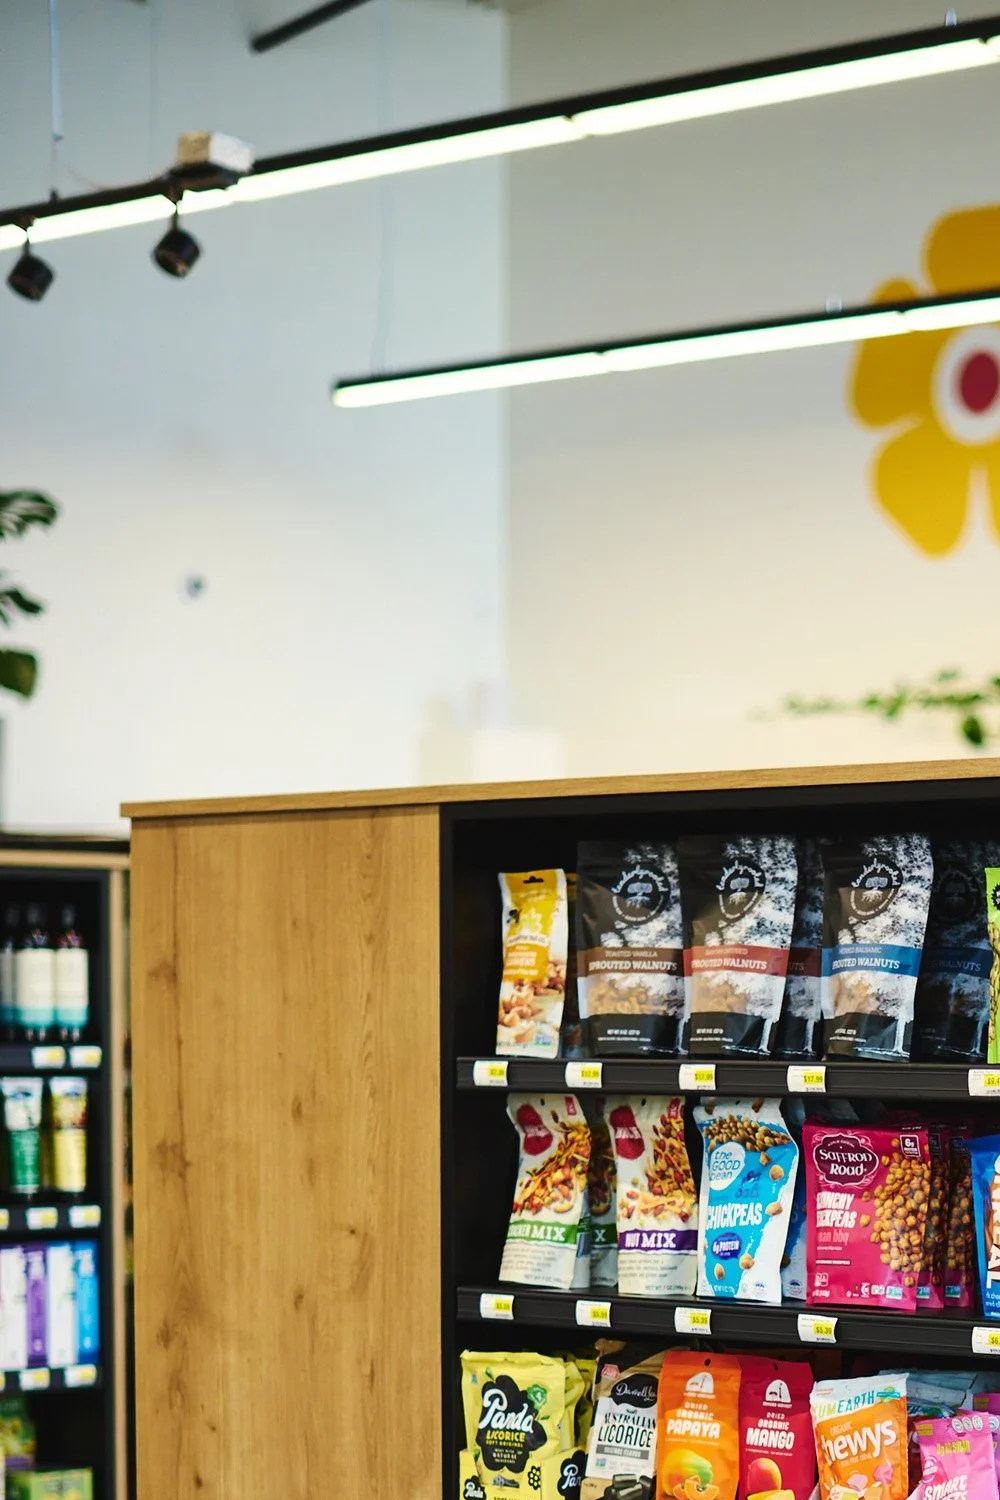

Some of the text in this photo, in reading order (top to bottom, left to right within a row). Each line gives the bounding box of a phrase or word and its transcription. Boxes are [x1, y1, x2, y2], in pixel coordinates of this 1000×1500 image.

[634, 960, 677, 971] WALNUTS
[722, 961, 767, 970] WALNUTS
[715, 1150, 732, 1160] the
[819, 1150, 871, 1163] Saffron
[712, 1160, 740, 1171] GOOD
[830, 1163, 864, 1176] Road
[710, 1170, 733, 1181] bean
[532, 1224, 565, 1241] MIX
[642, 1233, 677, 1249] MIX
[479, 1389, 535, 1432] Panda
[677, 1409, 713, 1421] ORGANIC
[667, 1421, 720, 1439] PAPAYA
[758, 1420, 789, 1431] ORGANIC
[486, 1430, 525, 1444] LICORICE
[598, 1425, 651, 1447] LICORICE
[746, 1428, 794, 1450] MANGO
